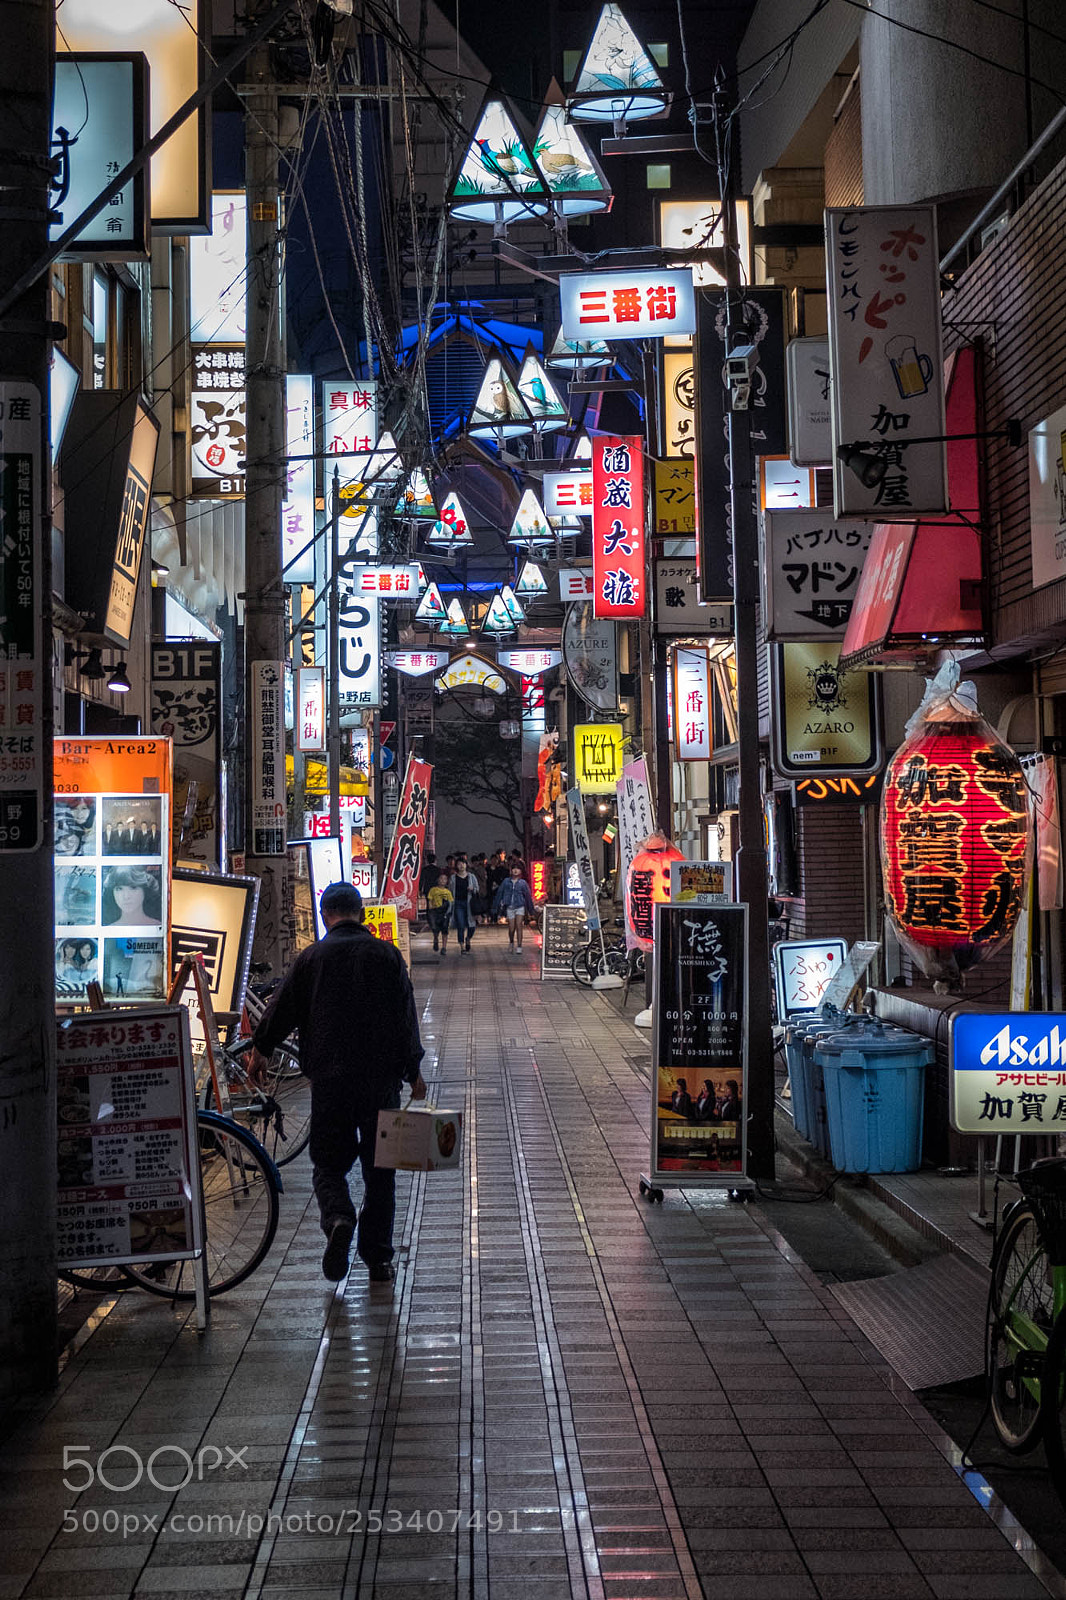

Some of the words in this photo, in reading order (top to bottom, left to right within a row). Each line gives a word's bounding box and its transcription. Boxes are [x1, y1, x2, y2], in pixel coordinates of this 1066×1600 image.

[579, 286, 677, 325] 三番街
[670, 468, 692, 480] スナ
[603, 446, 636, 605] 酒蔵大雅
[361, 573, 410, 591] 三番街
[568, 639, 609, 649] AZURE
[153, 650, 213, 677] B1F
[394, 654, 438, 667] 三番街
[509, 654, 551, 667] 三番街
[803, 722, 854, 734] AZARO
[126, 939, 158, 950] SOMEDAY
[697, 996, 710, 1004] 2F
[666, 1011, 679, 1020] 60
[702, 1011, 727, 1021] 1000
